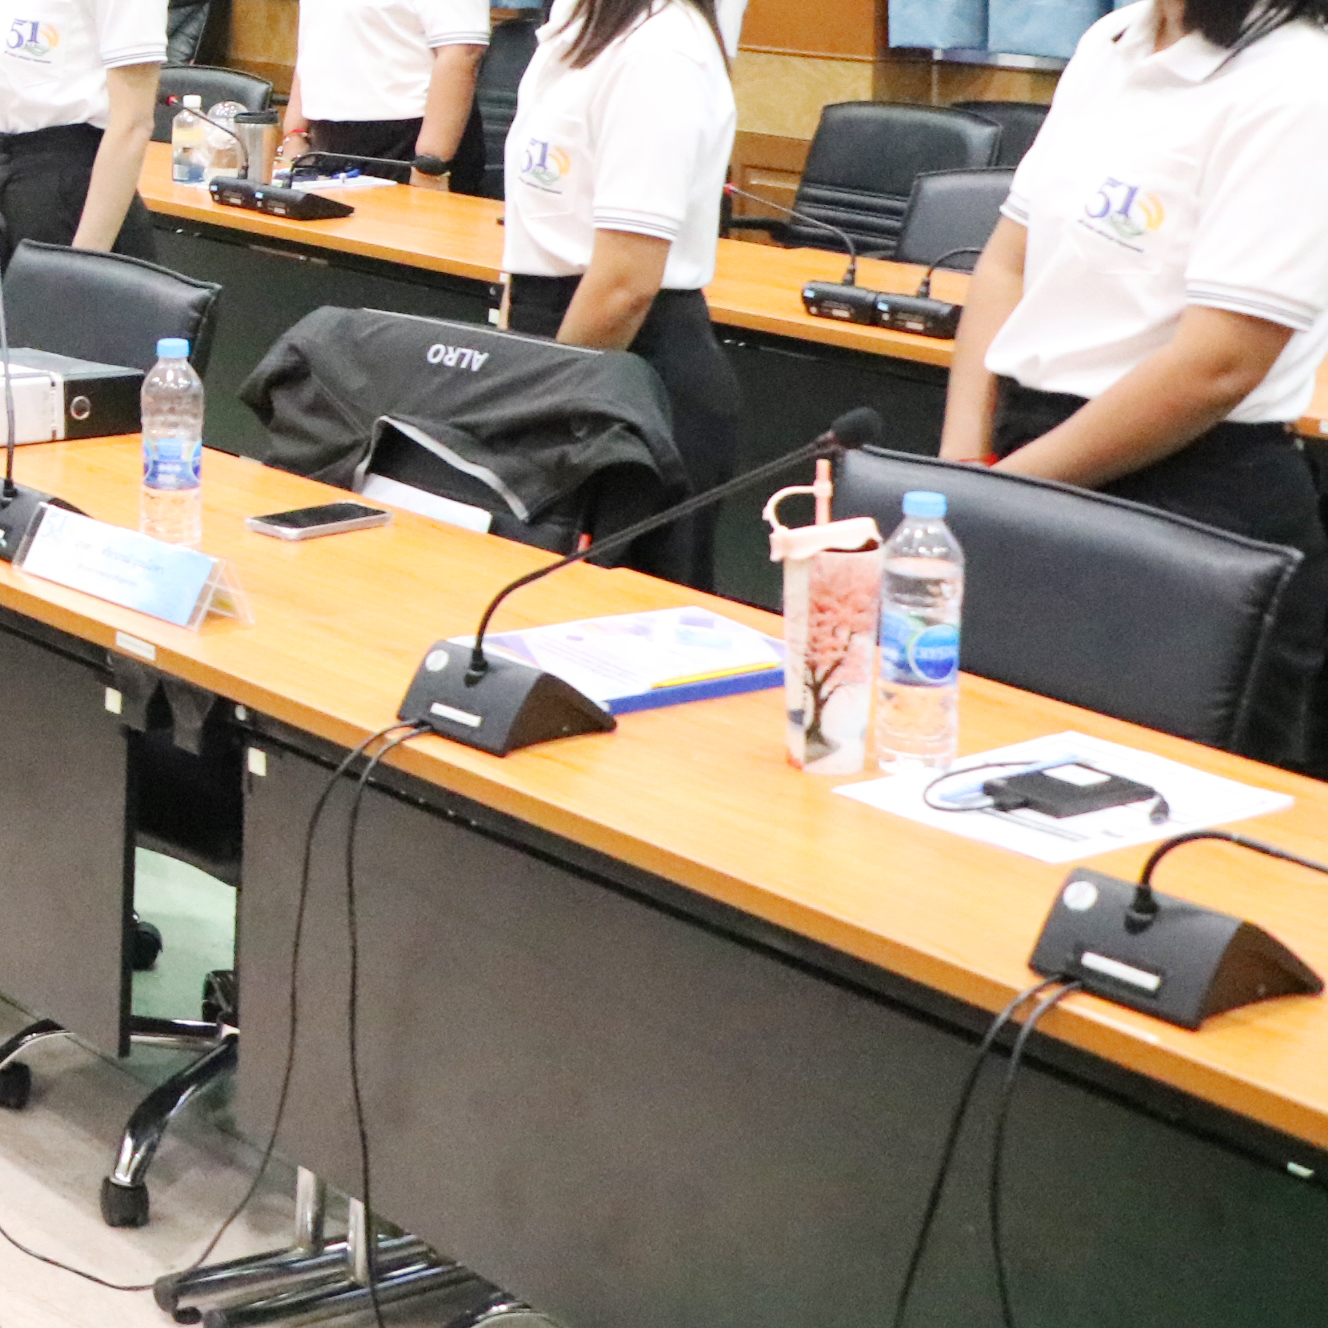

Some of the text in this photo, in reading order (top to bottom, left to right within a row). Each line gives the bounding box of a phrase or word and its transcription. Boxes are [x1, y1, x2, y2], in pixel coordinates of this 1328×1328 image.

[6, 18, 40, 49] 51
[1085, 176, 1141, 218] 51
[427, 343, 489, 371] ALRO
